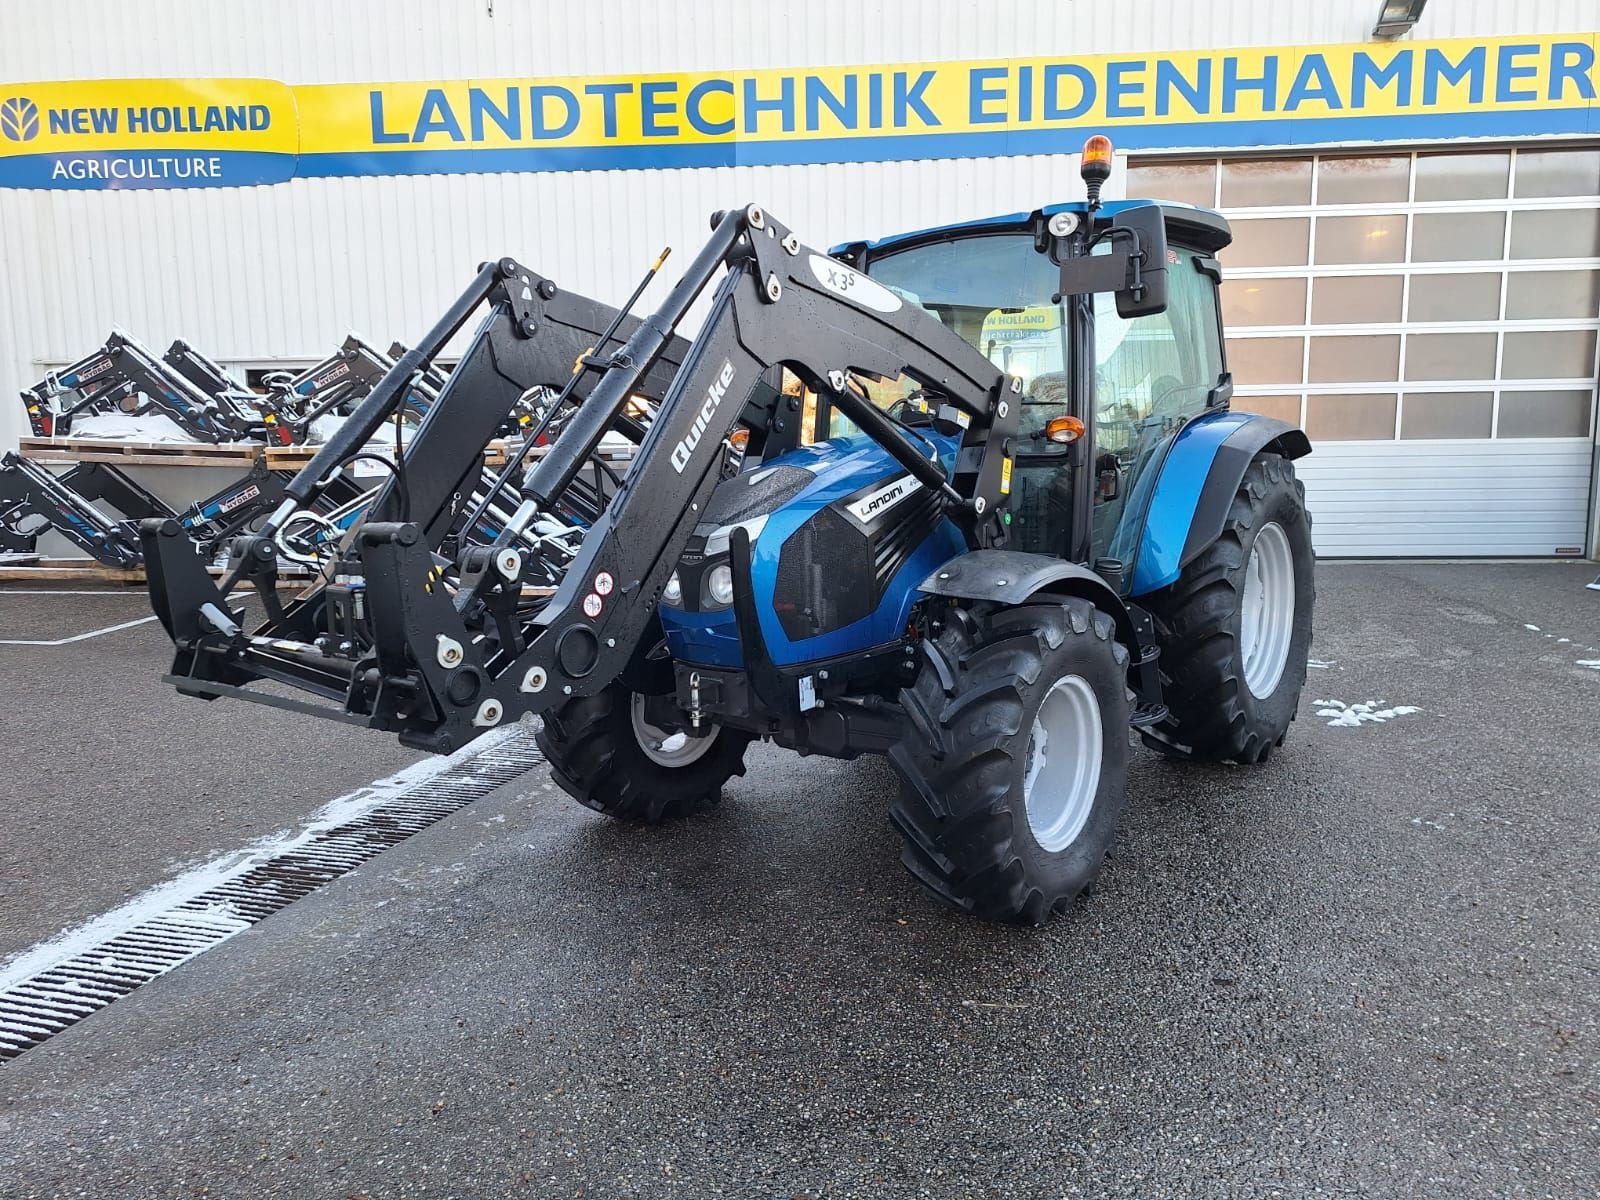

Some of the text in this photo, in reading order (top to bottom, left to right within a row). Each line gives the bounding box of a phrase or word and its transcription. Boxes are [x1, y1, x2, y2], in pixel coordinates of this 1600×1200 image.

[370, 42, 1597, 145] LANDTECHNIK EIDENHAMMER
[49, 105, 271, 134] NEW HOLLAND
[52, 157, 222, 180] AGRICULTURE
[84, 361, 111, 379] HYDRAC
[320, 367, 348, 386] HYDRAC
[671, 362, 734, 475] Quicke
[226, 490, 258, 509] HYDRAC
[860, 484, 903, 517] LANDINI
